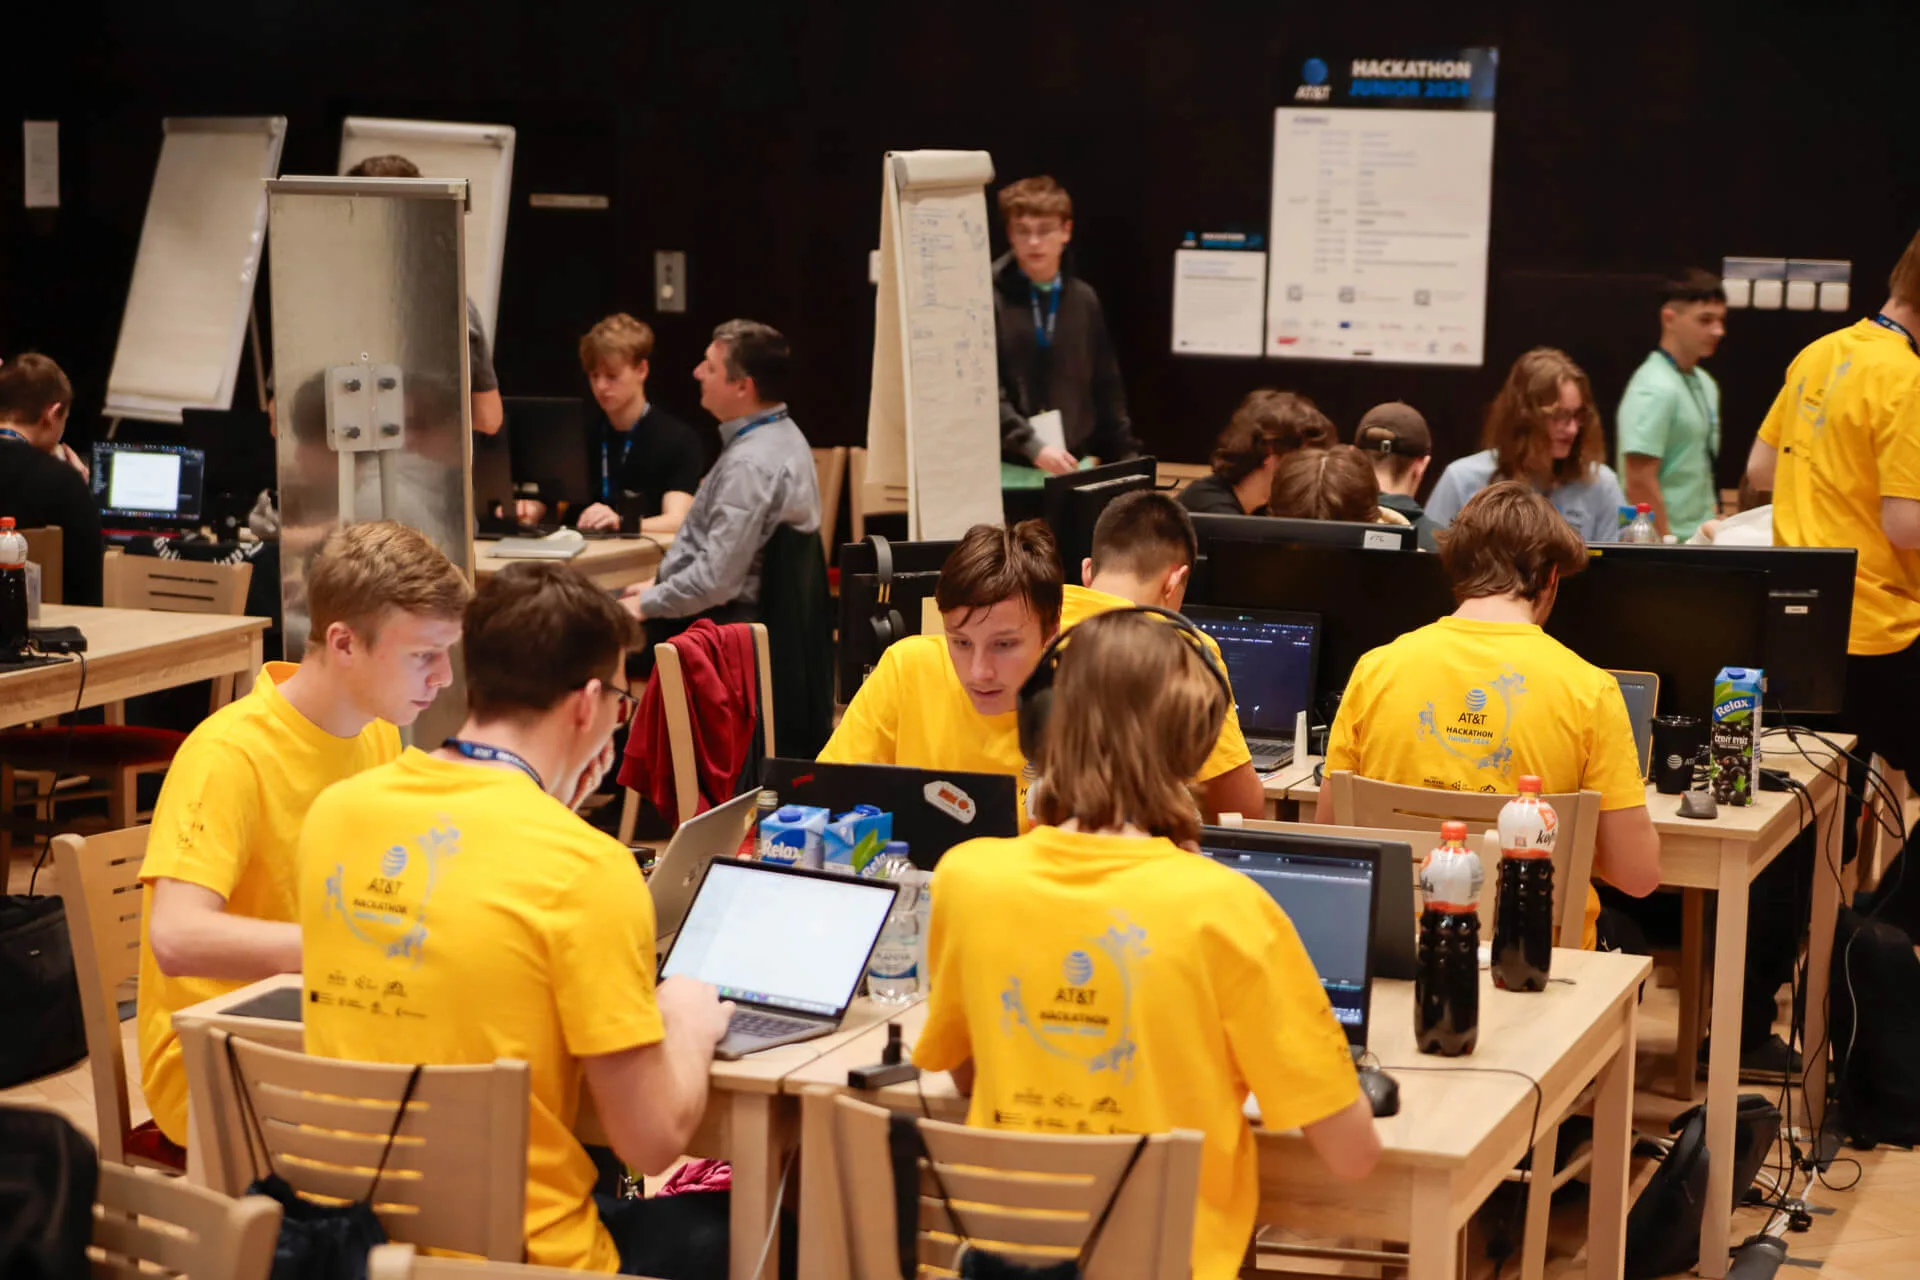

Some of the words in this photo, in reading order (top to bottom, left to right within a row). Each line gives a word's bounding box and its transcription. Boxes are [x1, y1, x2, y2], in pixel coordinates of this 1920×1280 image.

[1352, 59, 1471, 78] HACKATHON
[1294, 85, 1331, 100] AT&T
[1349, 79, 1420, 97] JUNIOR
[1715, 699, 1749, 717] Relax
[1457, 711, 1487, 725] AT&T
[1446, 726, 1494, 738] HACKATHON
[762, 839, 802, 859] Relax
[367, 877, 405, 895] AT&T
[352, 898, 408, 916] HACKATHON
[1053, 986, 1097, 1005] AT&T
[1039, 1010, 1110, 1025] HACKATHON
